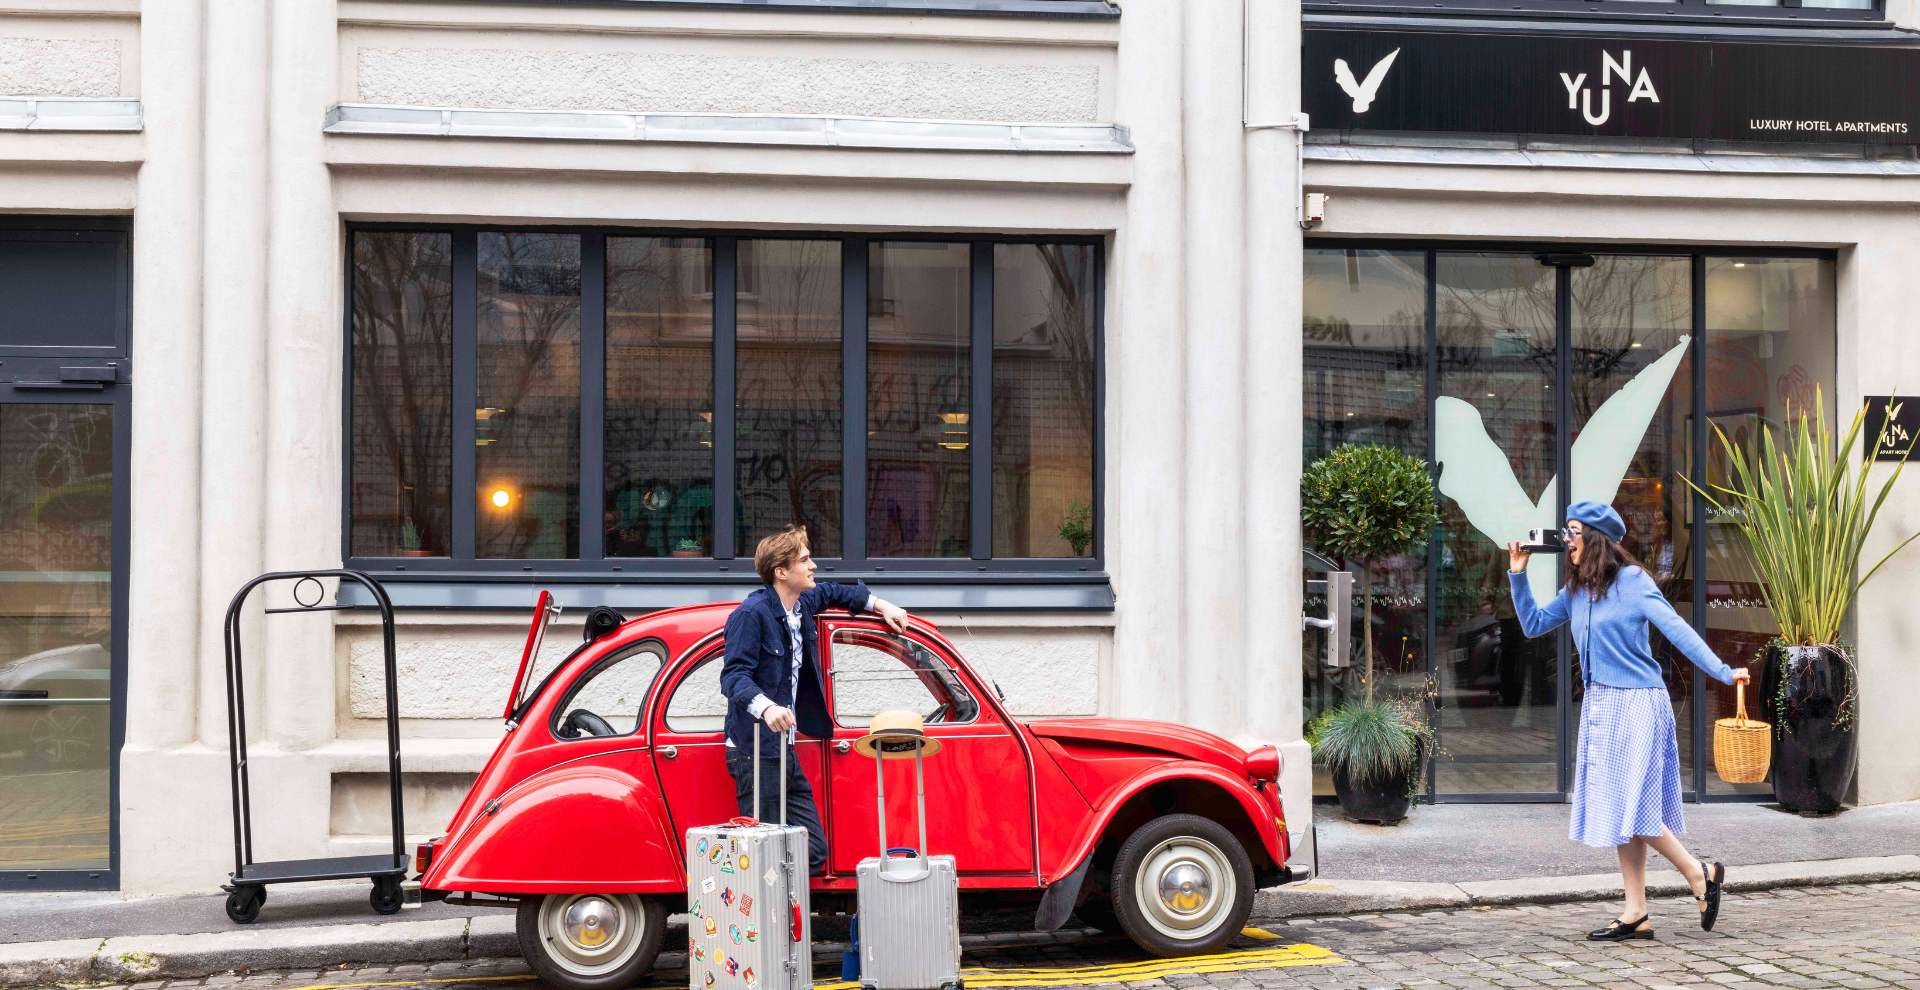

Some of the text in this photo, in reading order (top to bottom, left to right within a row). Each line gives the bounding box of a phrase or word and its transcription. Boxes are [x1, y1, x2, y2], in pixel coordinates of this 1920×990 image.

[1559, 49, 1660, 126] YUNA
[1750, 119, 1908, 133] LUXURY HOTEL APARTMENTS
[1880, 424, 1909, 447] YUNA
